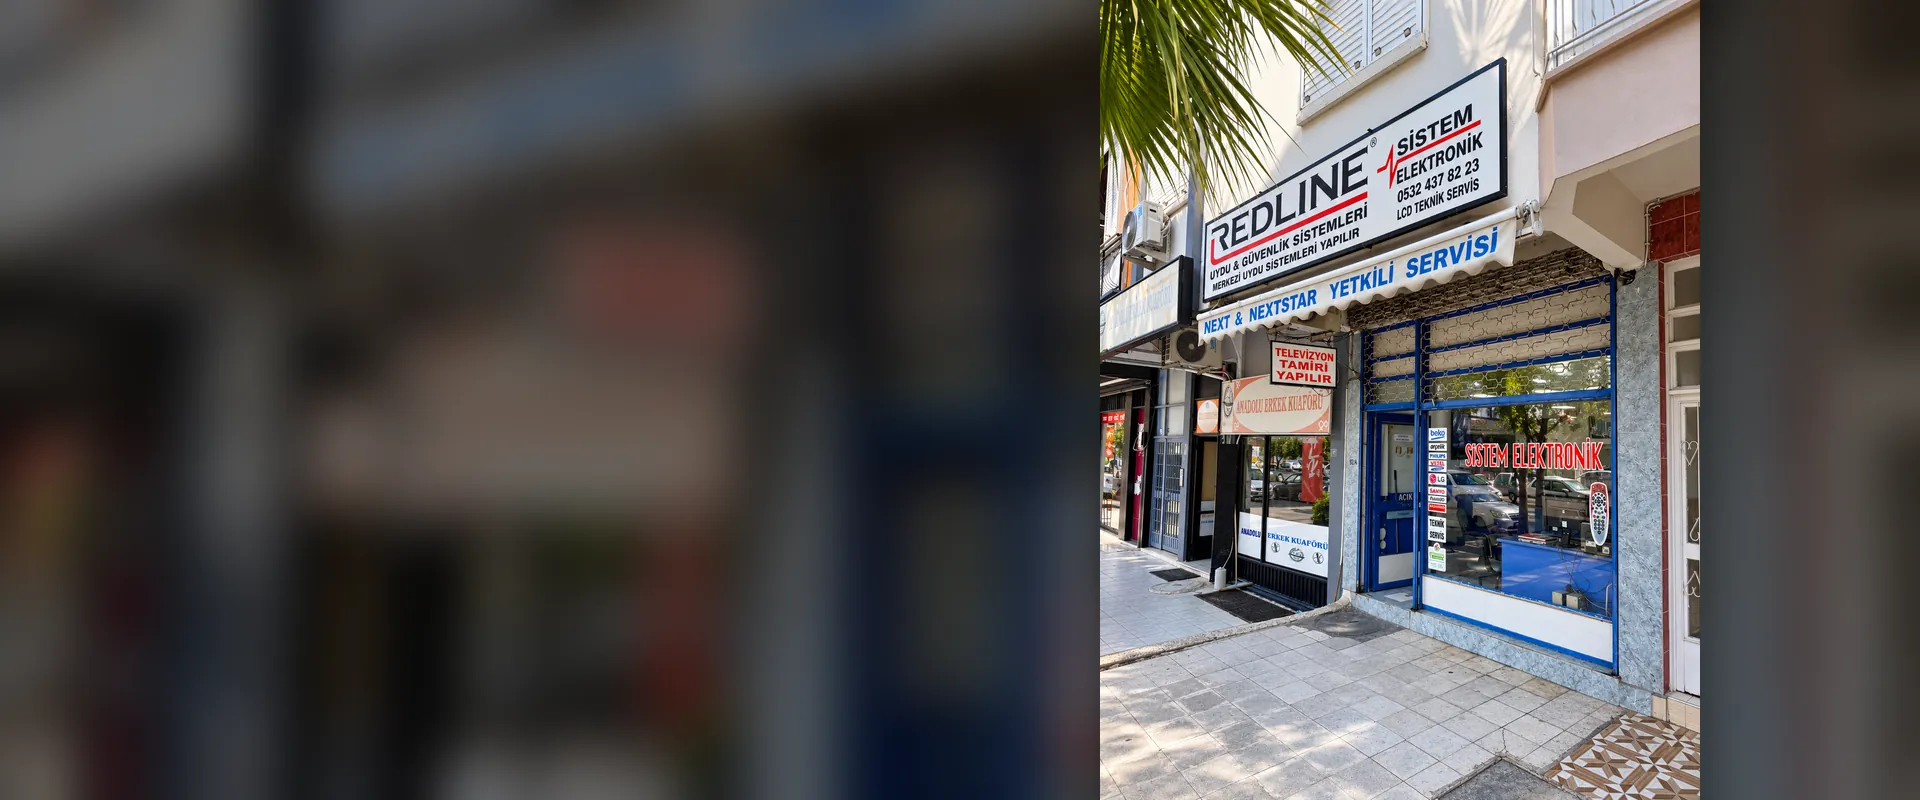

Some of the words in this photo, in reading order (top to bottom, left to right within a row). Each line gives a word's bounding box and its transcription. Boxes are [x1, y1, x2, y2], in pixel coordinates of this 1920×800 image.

[1397, 103, 1473, 156] SİSTEM
[1396, 131, 1484, 185] ELEKTRONİK
[1211, 145, 1369, 252] REDLINE
[1396, 204, 1412, 221] LCD
[1414, 190, 1445, 214] TEKNİK
[1446, 176, 1480, 202] SERVİS
[1397, 182, 1422, 203] 0532
[1424, 172, 1444, 191] 437
[1447, 165, 1461, 182] 82
[1465, 158, 1480, 176] 23
[1209, 264, 1231, 281] UYDU
[1233, 259, 1240, 271] &
[1241, 237, 1290, 267] GÜVENLİK
[1292, 201, 1369, 247] SİSTEMLERİ
[1212, 272, 1241, 292] MERKEZİ
[1242, 266, 1264, 281] UYDU
[1265, 242, 1318, 272] SİSTEMLERİ
[1319, 227, 1360, 250] YAPILIR
[1203, 314, 1231, 335] NEXT
[1234, 311, 1243, 326] &
[1249, 289, 1318, 323] NEXTSTAR
[1329, 260, 1395, 300] YETKİLİ
[1405, 225, 1499, 279] SERVİSİ
[1274, 347, 1334, 362] TELEVİZYON
[1279, 359, 1329, 373] TAMİRİ
[1276, 370, 1332, 384] YAPILIR
[1236, 398, 1263, 415] ANADOLU
[1264, 397, 1288, 413] ERKEK
[1430, 429, 1446, 437] beko
[1464, 442, 1509, 468] SİSTEM
[1512, 437, 1604, 471] ELEKTRONİK
[1398, 493, 1413, 502] AÇIK
[1240, 527, 1262, 538] ANADOLU
[1267, 532, 1290, 543] ERKEK
[1291, 536, 1329, 551] KUAFÖRÜ
